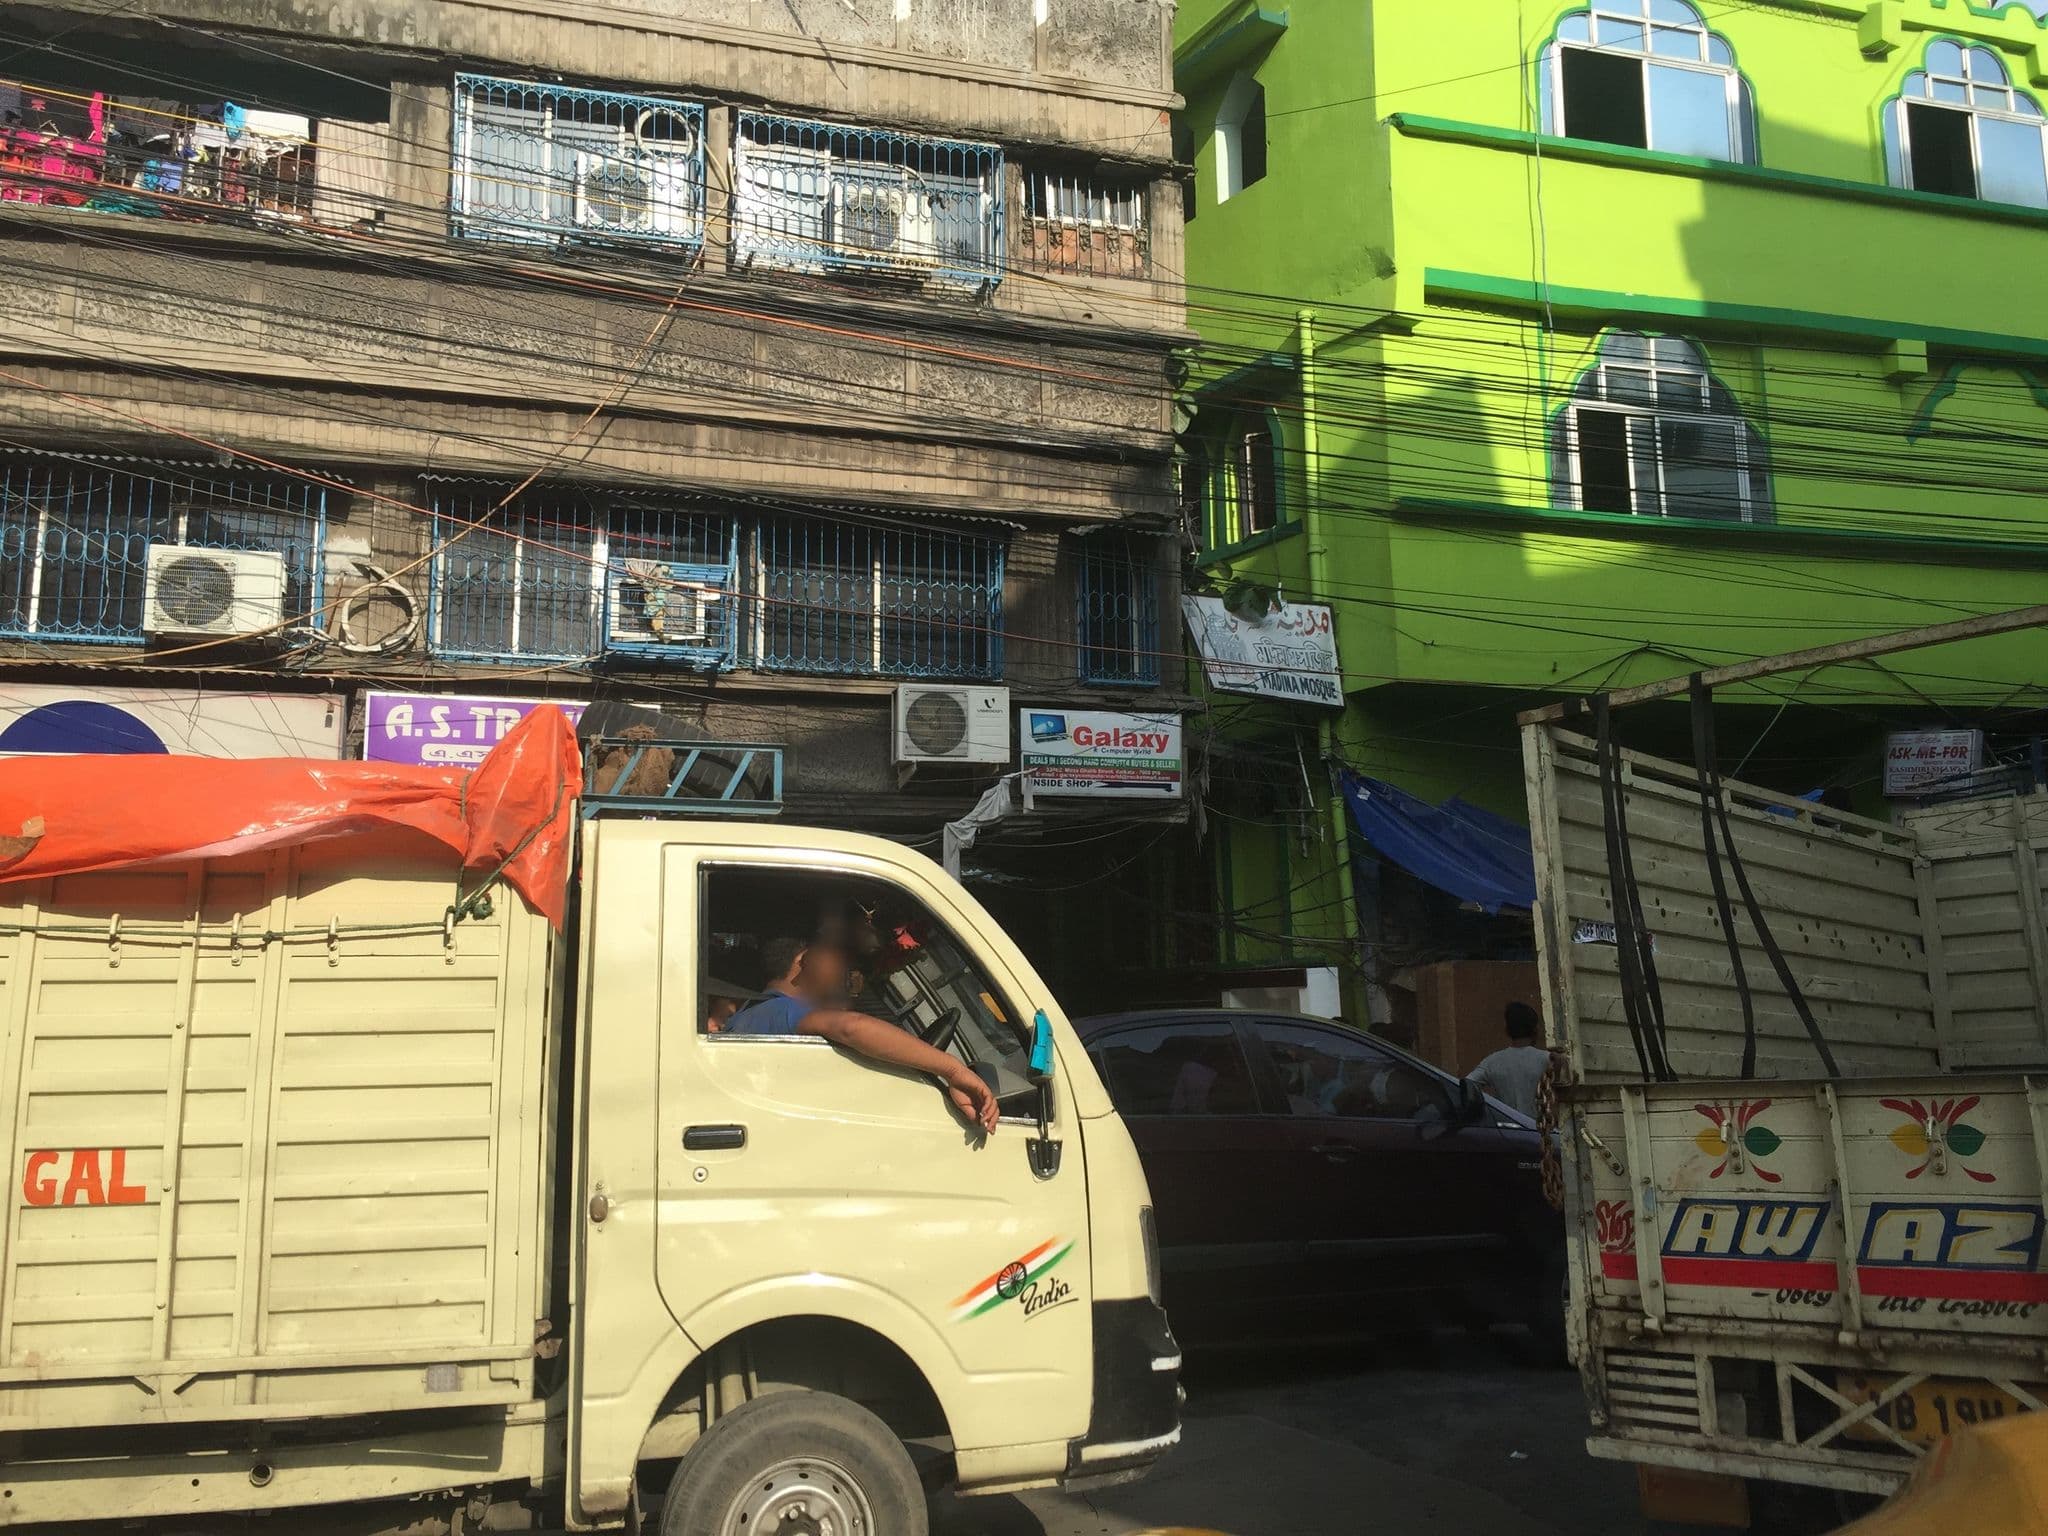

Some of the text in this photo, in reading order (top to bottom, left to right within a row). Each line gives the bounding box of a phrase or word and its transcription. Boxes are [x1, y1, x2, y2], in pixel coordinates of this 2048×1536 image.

[1260, 671, 1299, 695] MADINA
[1299, 677, 1338, 701] MOSQUE
[386, 703, 461, 740] A.S.
[1073, 726, 1170, 753] Galaxy
[1101, 747, 1132, 756] Computer
[1133, 748, 1152, 757] World
[1889, 746, 1968, 760] ASK-ME-FOR
[1029, 756, 1049, 765] DEALS
[1060, 757, 1083, 766] SECOND
[1083, 759, 1099, 767] HAND
[1131, 760, 1149, 769] BUYER
[1155, 761, 1176, 770] SELLER
[1033, 779, 1093, 788] NSIDE SHOP
[23, 1148, 147, 1206] GAL
[1019, 1277, 1072, 1316] India
